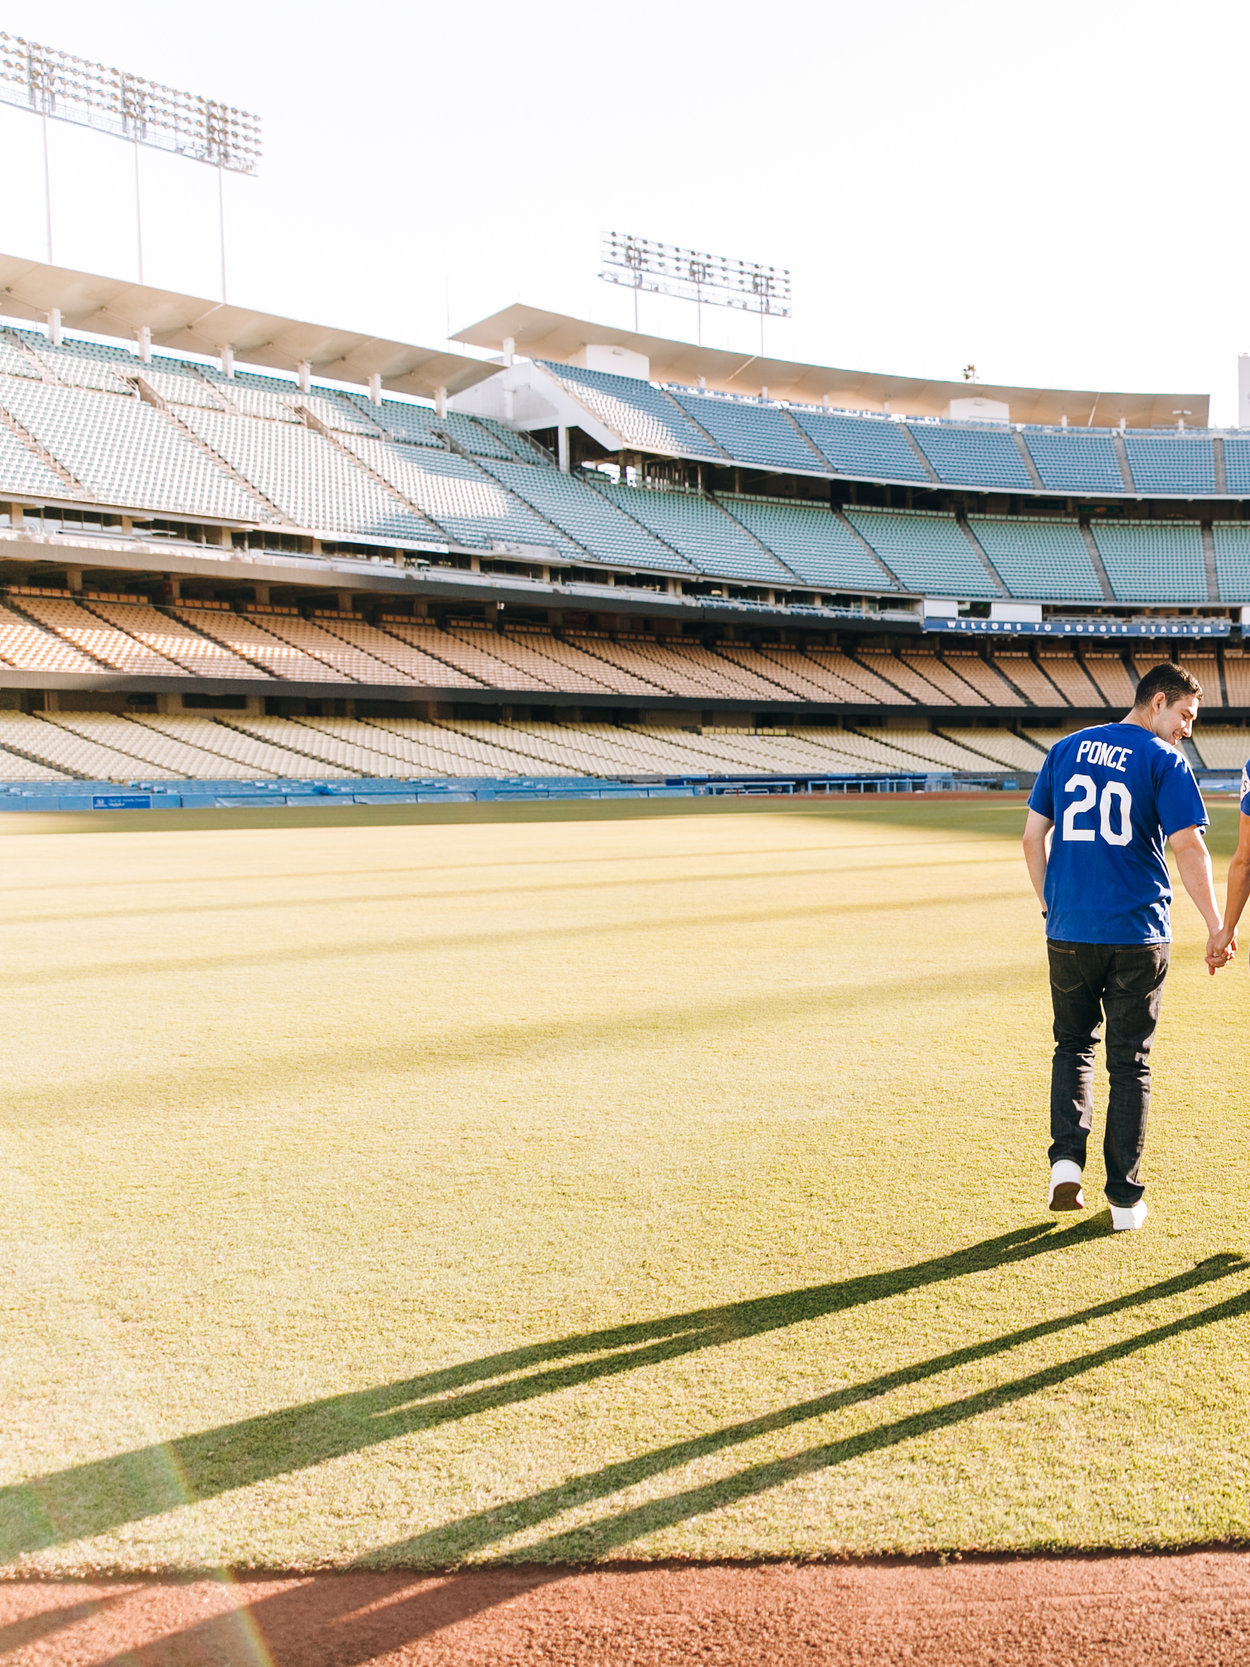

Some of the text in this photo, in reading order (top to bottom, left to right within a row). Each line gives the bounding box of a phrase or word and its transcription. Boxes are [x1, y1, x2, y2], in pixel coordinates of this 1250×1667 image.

[947, 621, 1212, 634] WELCOME TO DODGER STADIUM
[1076, 740, 1133, 772] PONCE
[1062, 773, 1133, 847] 20
